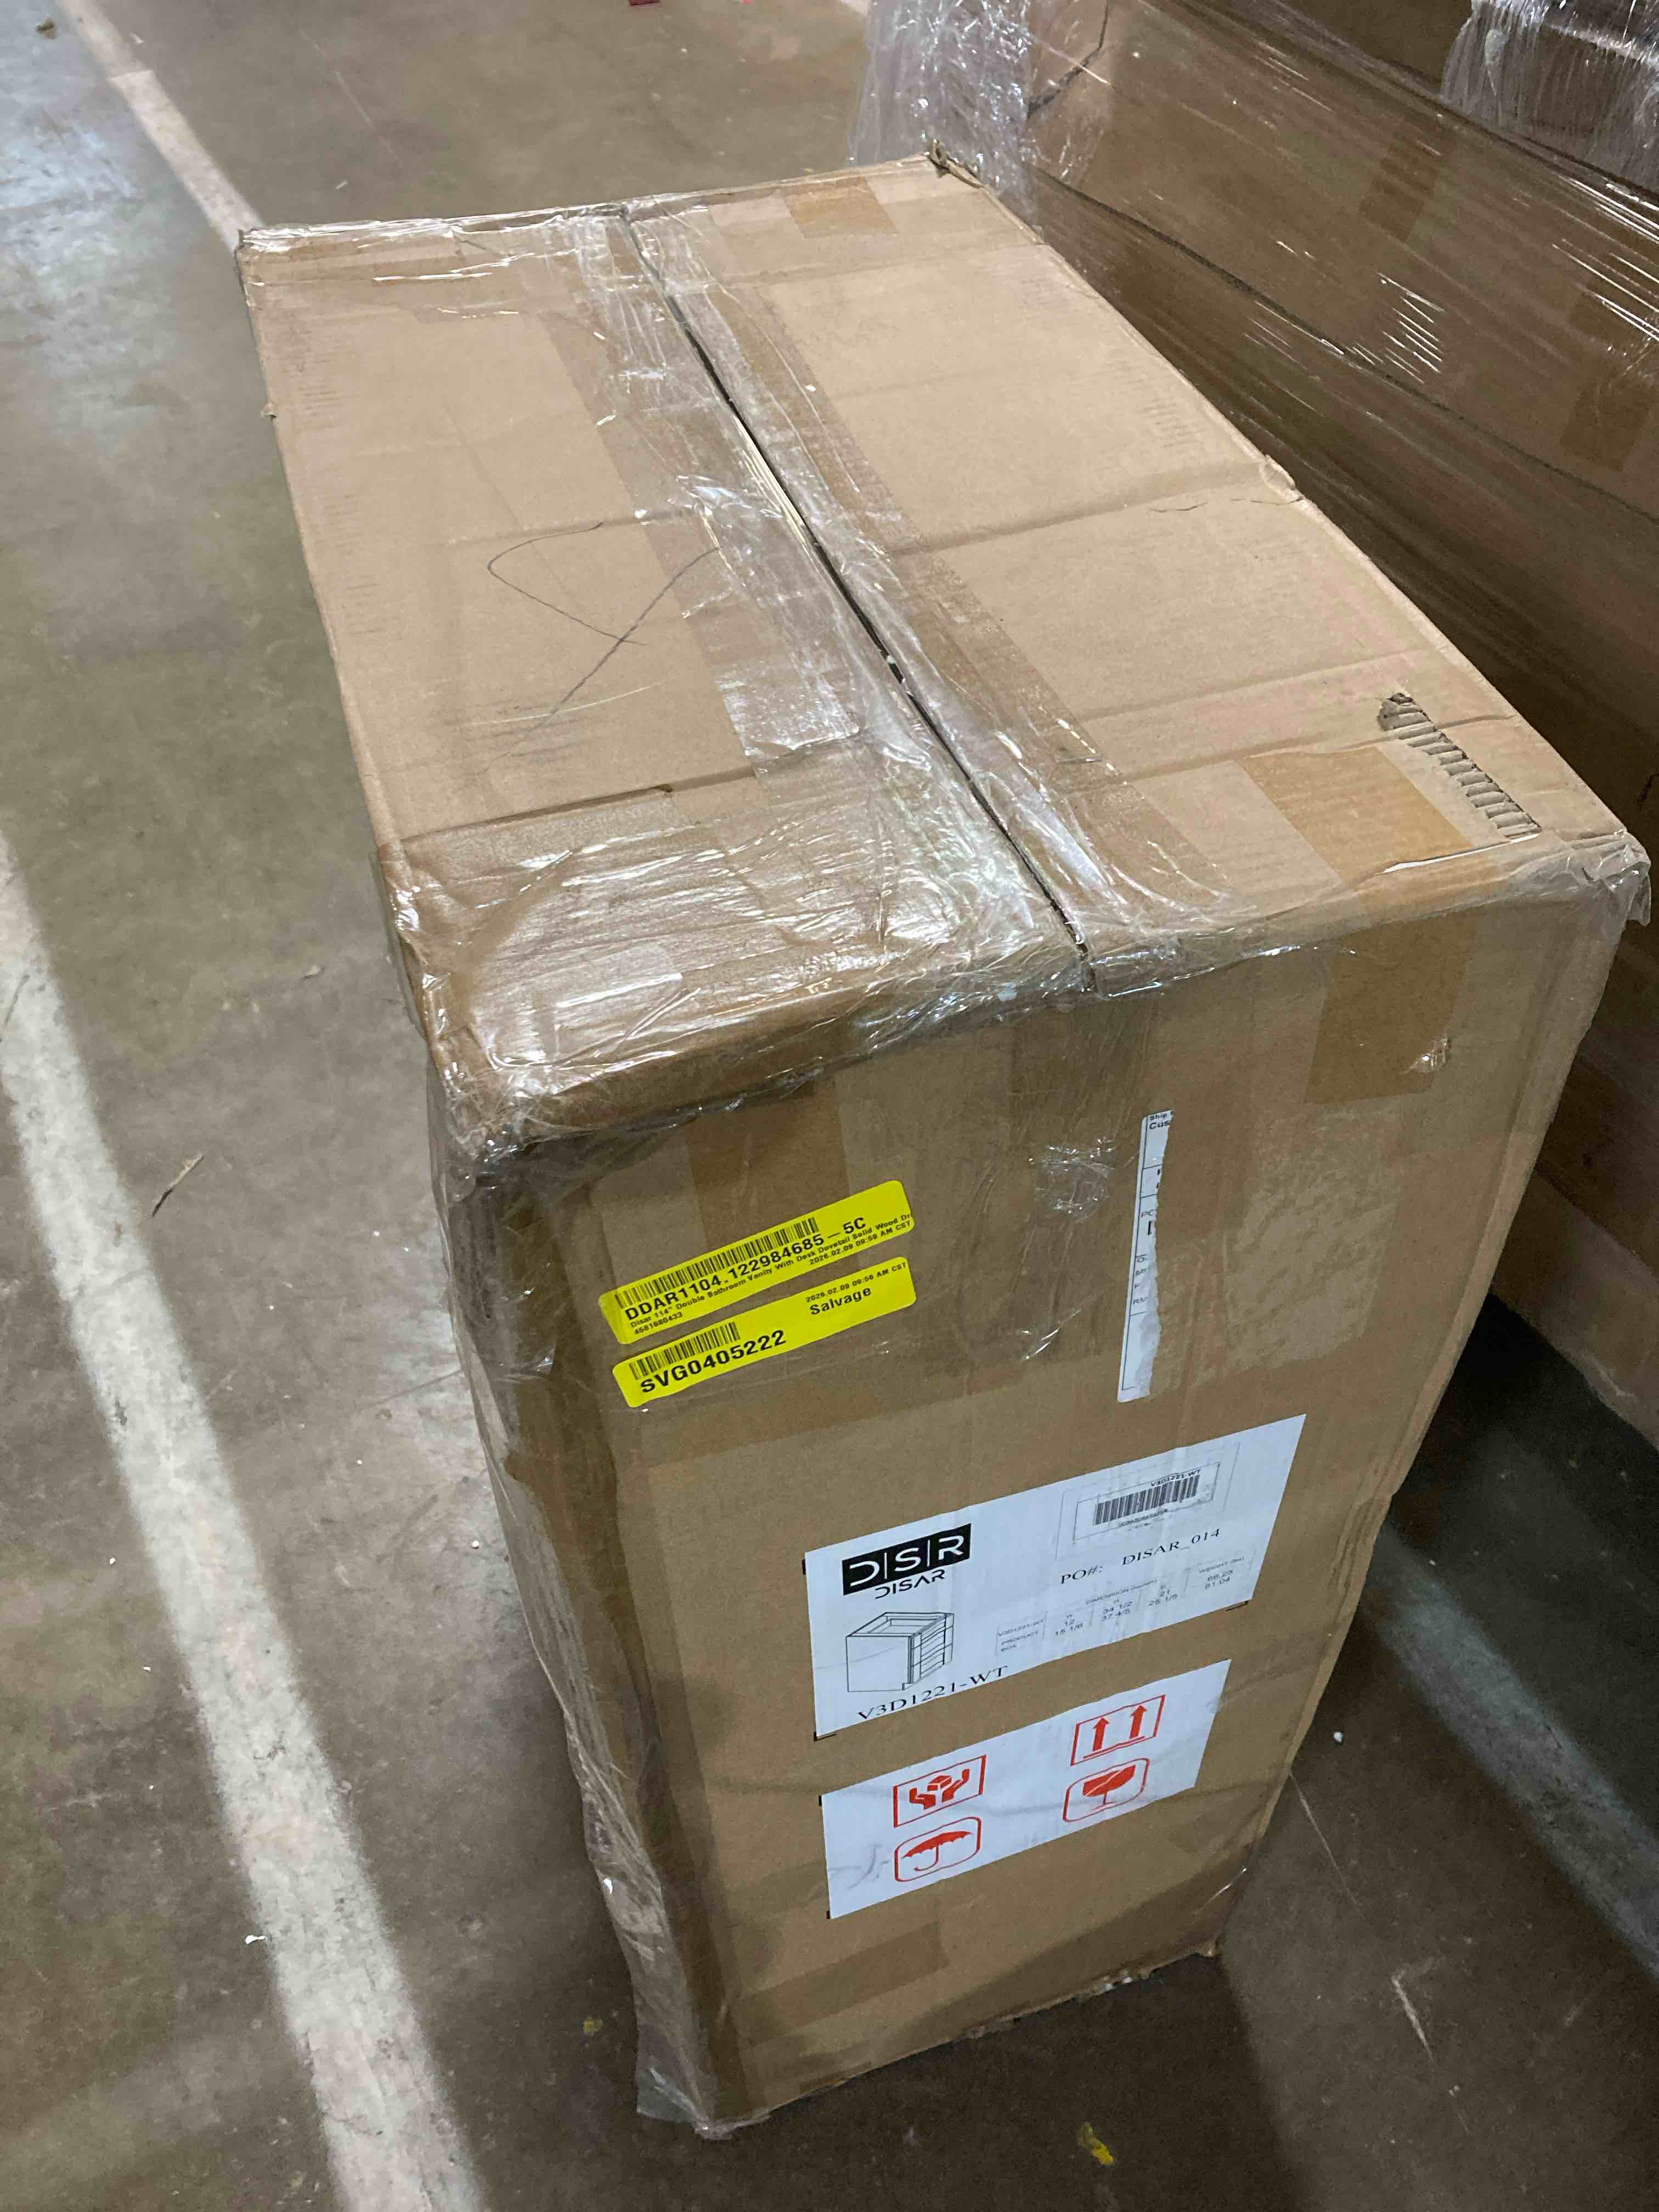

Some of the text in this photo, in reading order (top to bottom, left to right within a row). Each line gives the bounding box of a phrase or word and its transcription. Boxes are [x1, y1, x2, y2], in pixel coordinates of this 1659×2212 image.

[880, 1227, 893, 1237] AM
[895, 1220, 911, 1231] CST
[625, 1233, 824, 1320] DDAR1104.122984685
[843, 1217, 866, 1234] 5C
[676, 1295, 705, 1310] Double
[707, 1279, 746, 1298] Bathroom
[747, 1266, 772, 1281] Vanity
[775, 1259, 794, 1270] With
[796, 1251, 815, 1262] Desk
[818, 1237, 850, 1253] Dovetail
[852, 1227, 872, 1240] Solid
[876, 1217, 898, 1230] Wood
[877, 1268, 889, 1278] AM
[891, 1262, 907, 1272] CST
[810, 1287, 872, 1315] Salvage
[640, 1329, 786, 1393] SVG0405222
[1060, 1528, 1221, 1584] PO#: DISAR_014
[875, 1569, 945, 1599] DISAR
[857, 1665, 1008, 1720] V3D1221-WT
